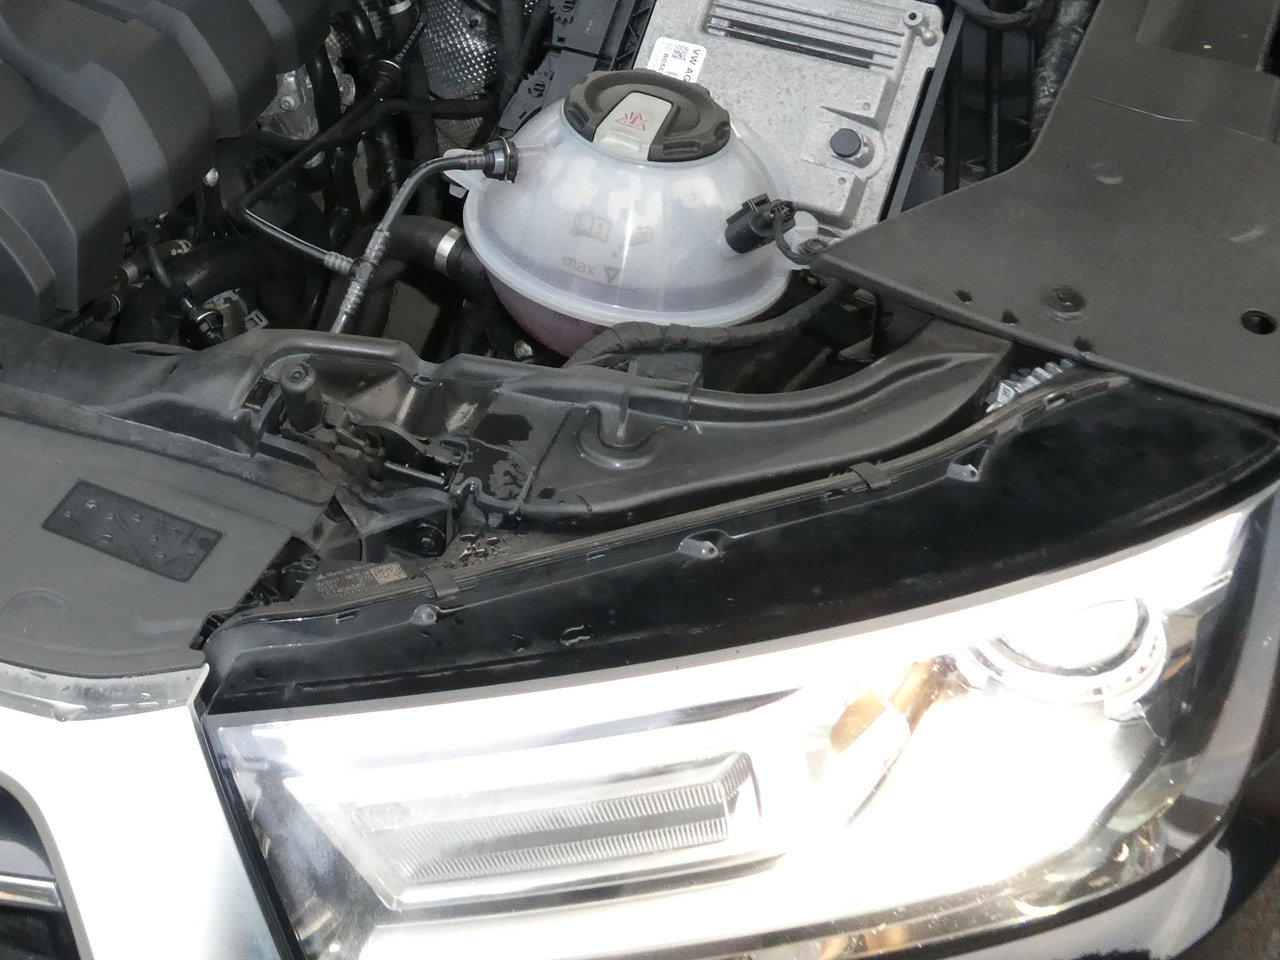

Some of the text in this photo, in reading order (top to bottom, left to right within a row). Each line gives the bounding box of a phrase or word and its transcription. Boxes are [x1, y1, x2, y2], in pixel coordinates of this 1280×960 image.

[657, 53, 669, 72] BOSC
[689, 49, 702, 66] VW
[563, 256, 596, 277] max
